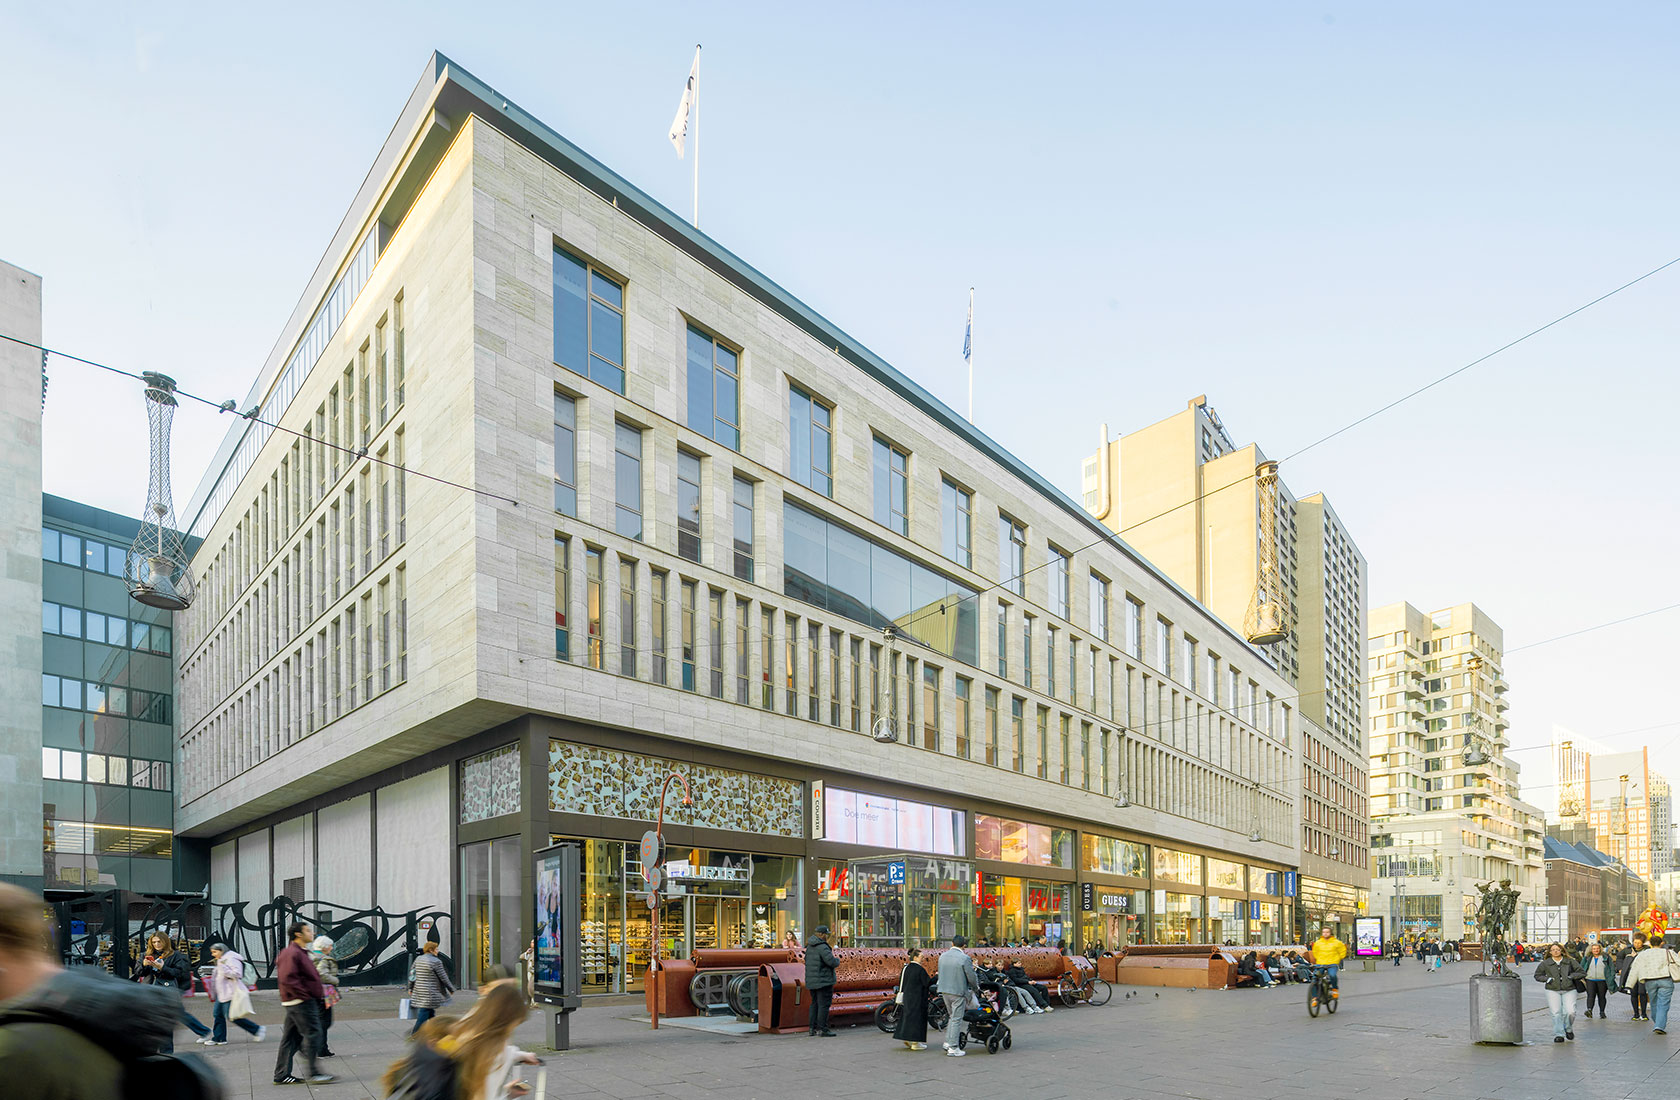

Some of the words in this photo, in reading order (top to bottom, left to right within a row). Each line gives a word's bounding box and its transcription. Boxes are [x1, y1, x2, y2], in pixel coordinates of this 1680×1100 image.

[844, 808, 859, 819] Doe
[860, 811, 879, 822] meer
[1102, 894, 1127, 906] GUESS
